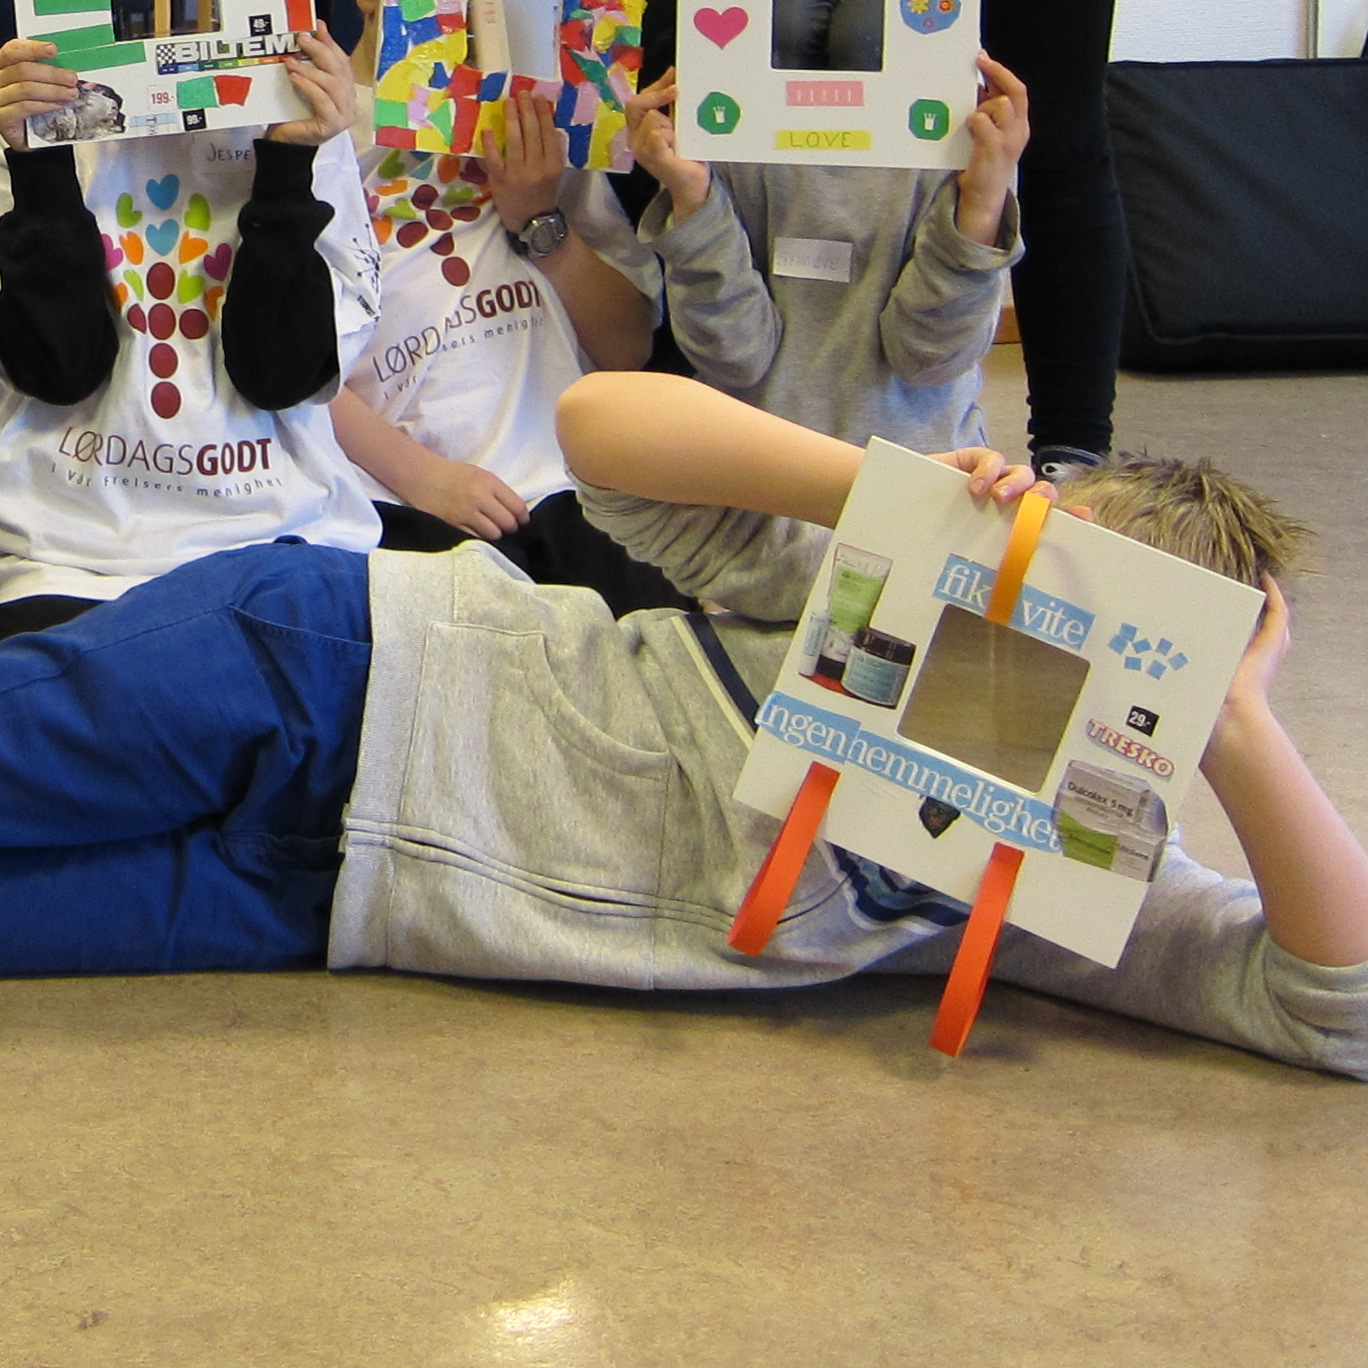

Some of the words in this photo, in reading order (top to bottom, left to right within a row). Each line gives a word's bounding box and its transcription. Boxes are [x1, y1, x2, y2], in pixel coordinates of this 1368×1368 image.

[175, 33, 303, 64] BILTEM
[206, 142, 251, 162] JESPE
[789, 132, 851, 148] LOVE
[58, 426, 272, 476] LØRDAGSGODT
[196, 477, 283, 498] menighet
[1022, 600, 1085, 646] vite
[1087, 718, 1175, 778] TRESKO
